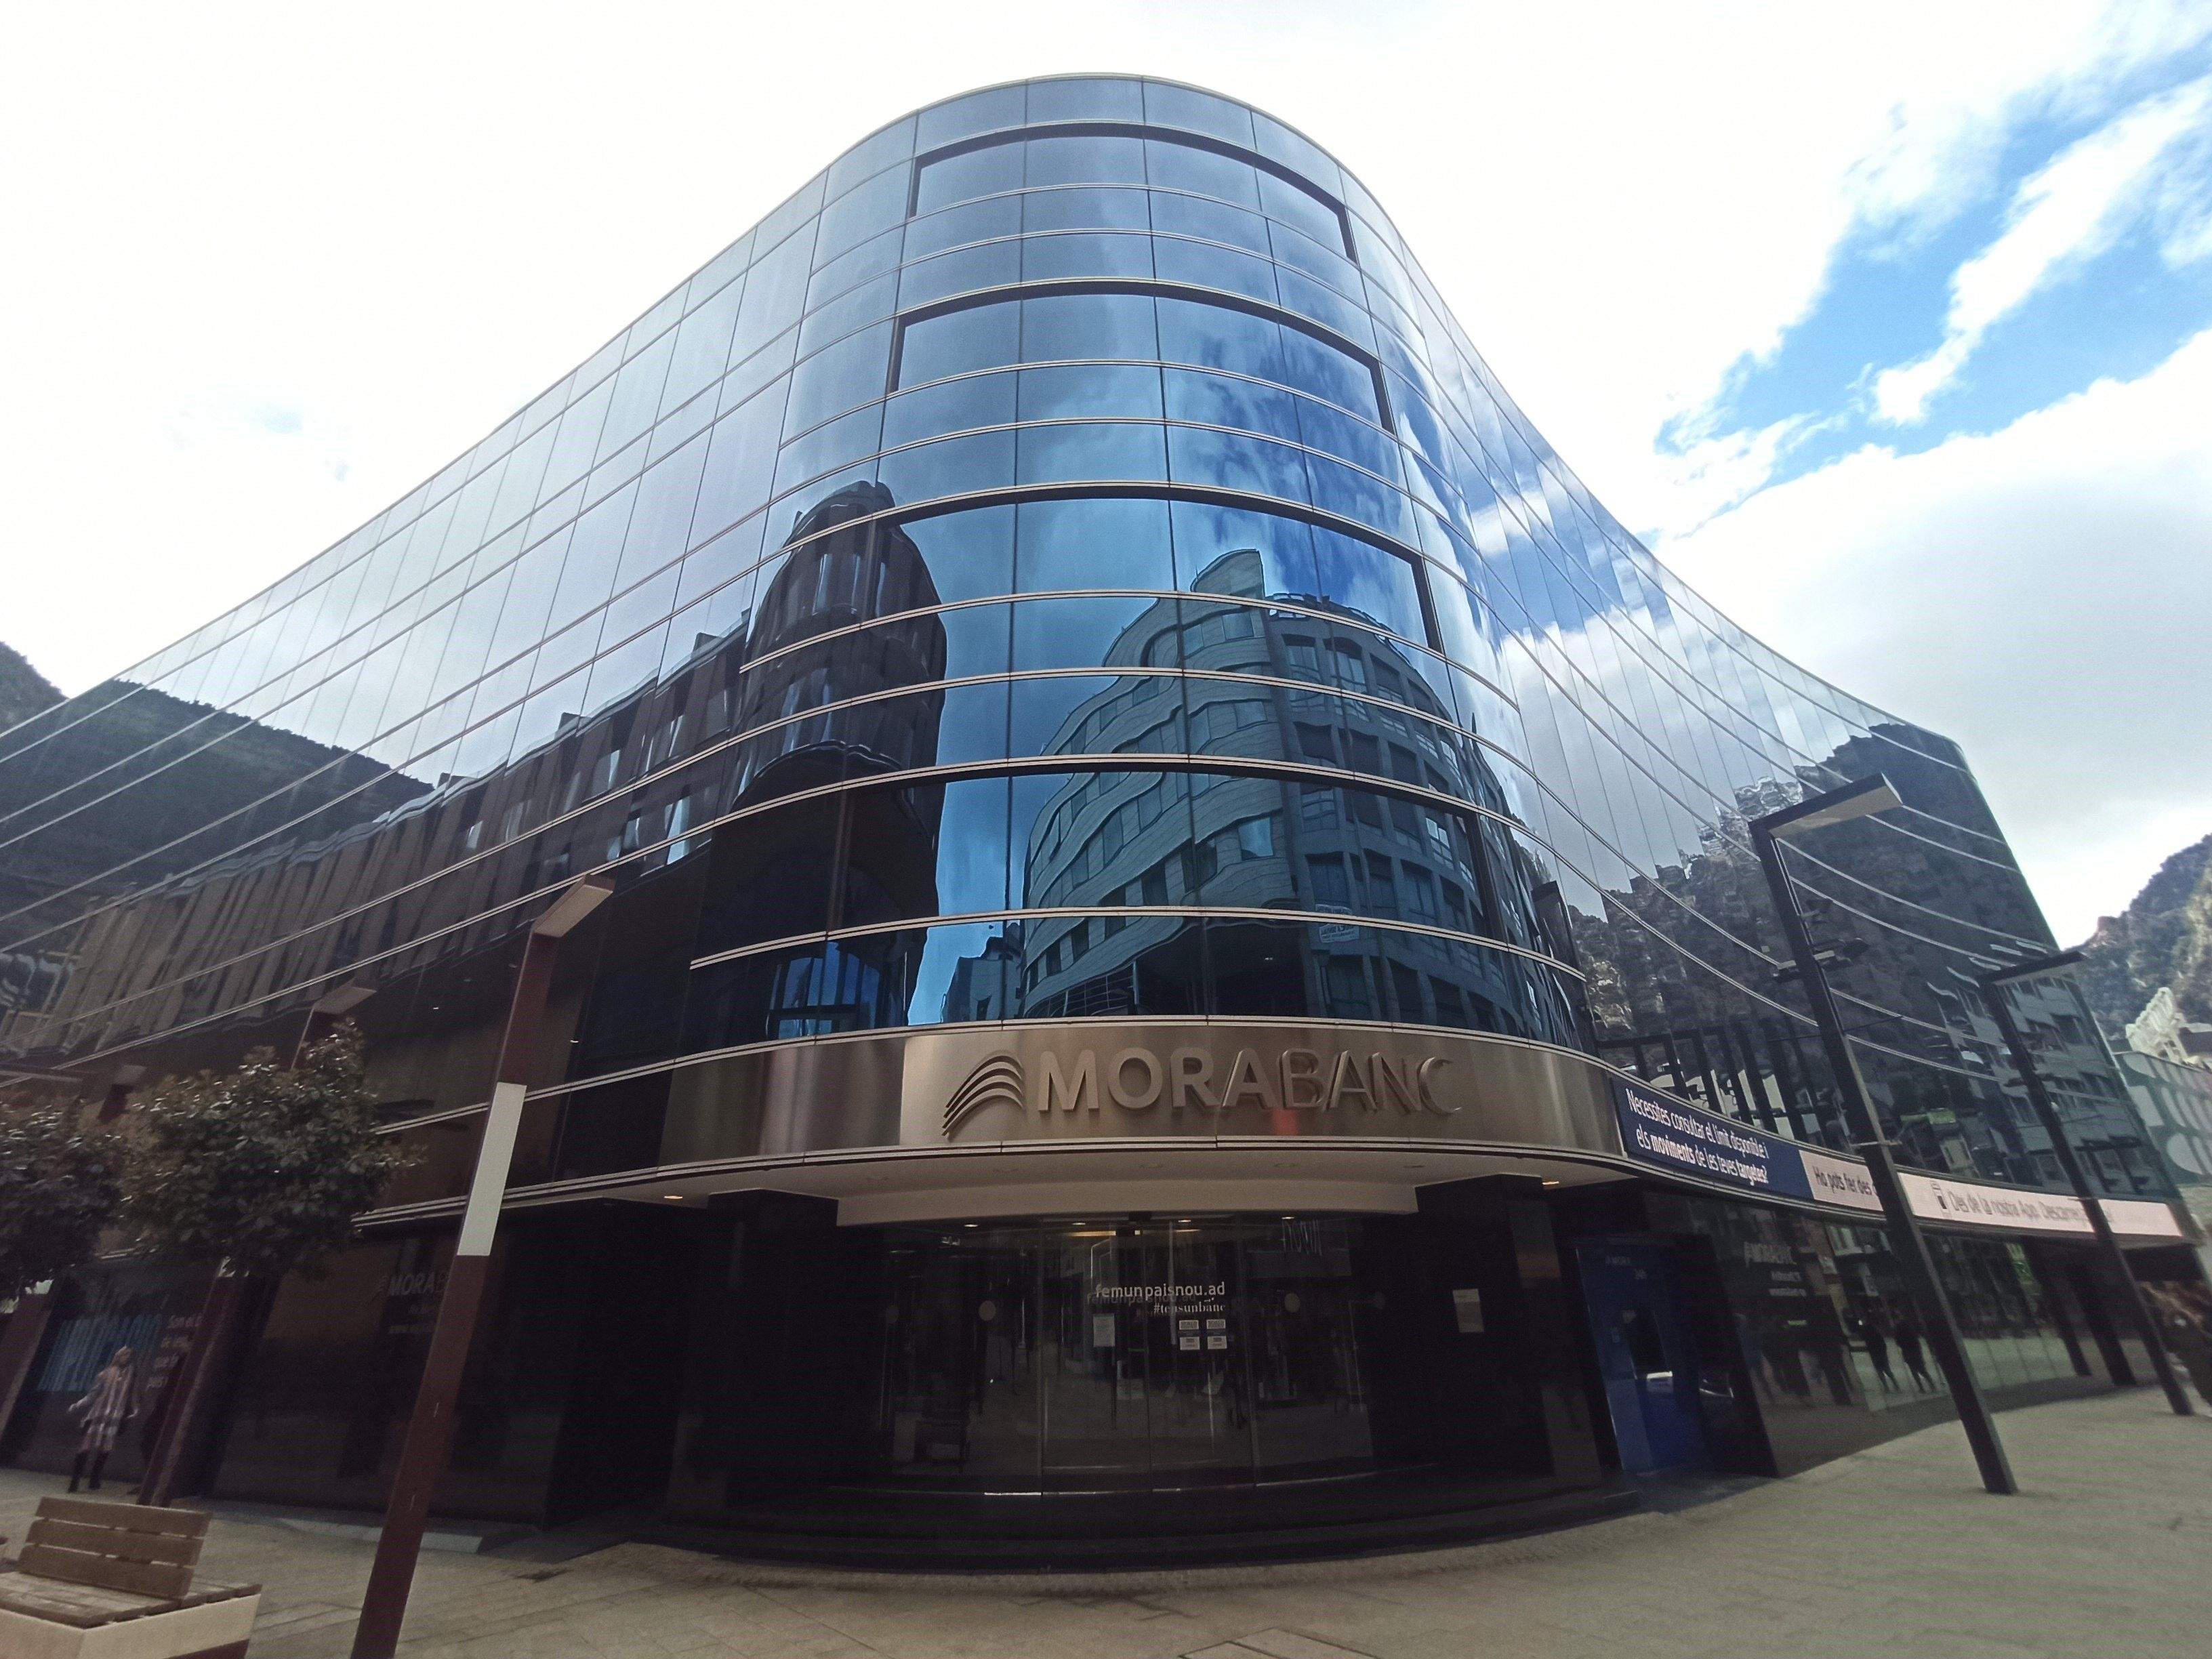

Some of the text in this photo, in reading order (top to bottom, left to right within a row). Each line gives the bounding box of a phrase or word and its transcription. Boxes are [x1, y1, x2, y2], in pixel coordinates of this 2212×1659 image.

[1038, 1048, 1462, 1115] MORABANC
[1626, 1088, 1671, 1126] Necessites
[1671, 1113, 1706, 1139] consultar
[1705, 1122, 1717, 1143] el
[1730, 1130, 1765, 1158] disponible
[1762, 1142, 1769, 1159] i
[1636, 1124, 1769, 1186] els moviments de les teves targetes?
[1812, 1166, 1828, 1187] Ho
[1827, 1172, 1845, 1194] pots
[1843, 1172, 1858, 1193] fer
[1858, 1175, 1872, 1195] des
[389, 1271, 448, 1296] MORAB
[1095, 1281, 1225, 1301] femunpaisnou.ad
